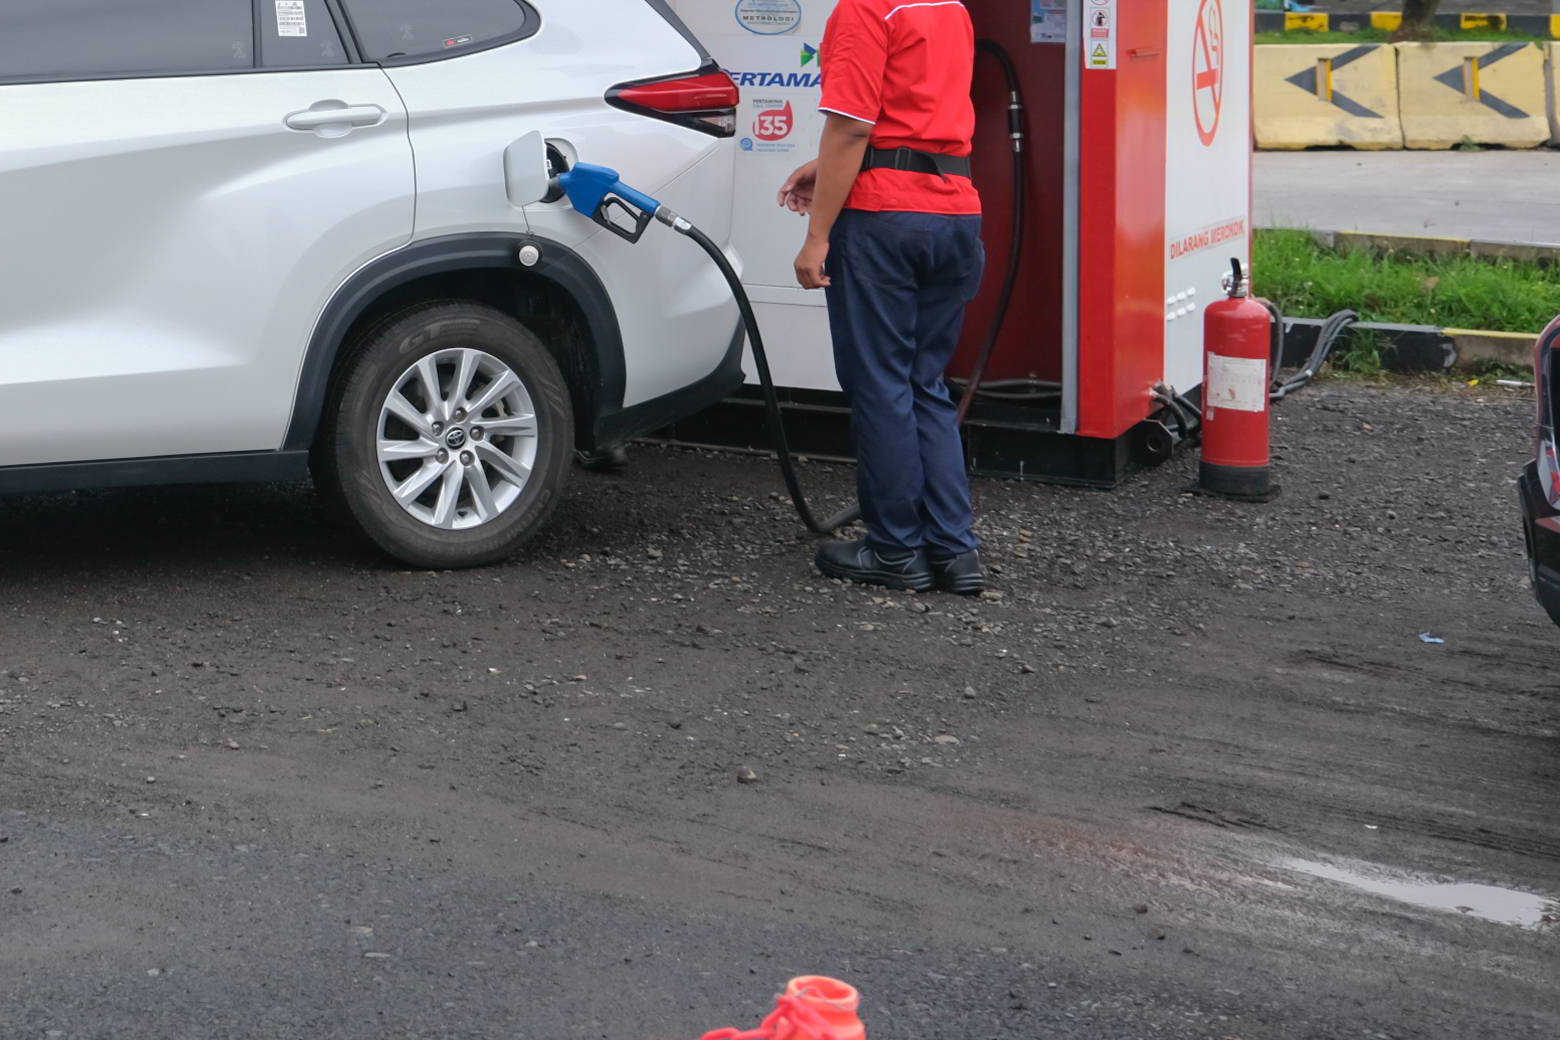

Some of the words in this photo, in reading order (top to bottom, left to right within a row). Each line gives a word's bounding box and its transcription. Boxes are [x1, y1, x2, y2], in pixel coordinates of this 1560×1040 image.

[722, 68, 822, 87] ERTAMA
[754, 116, 788, 136] 135
[1170, 230, 1210, 260] DILARANG
[1211, 219, 1245, 245] MEROKOK
